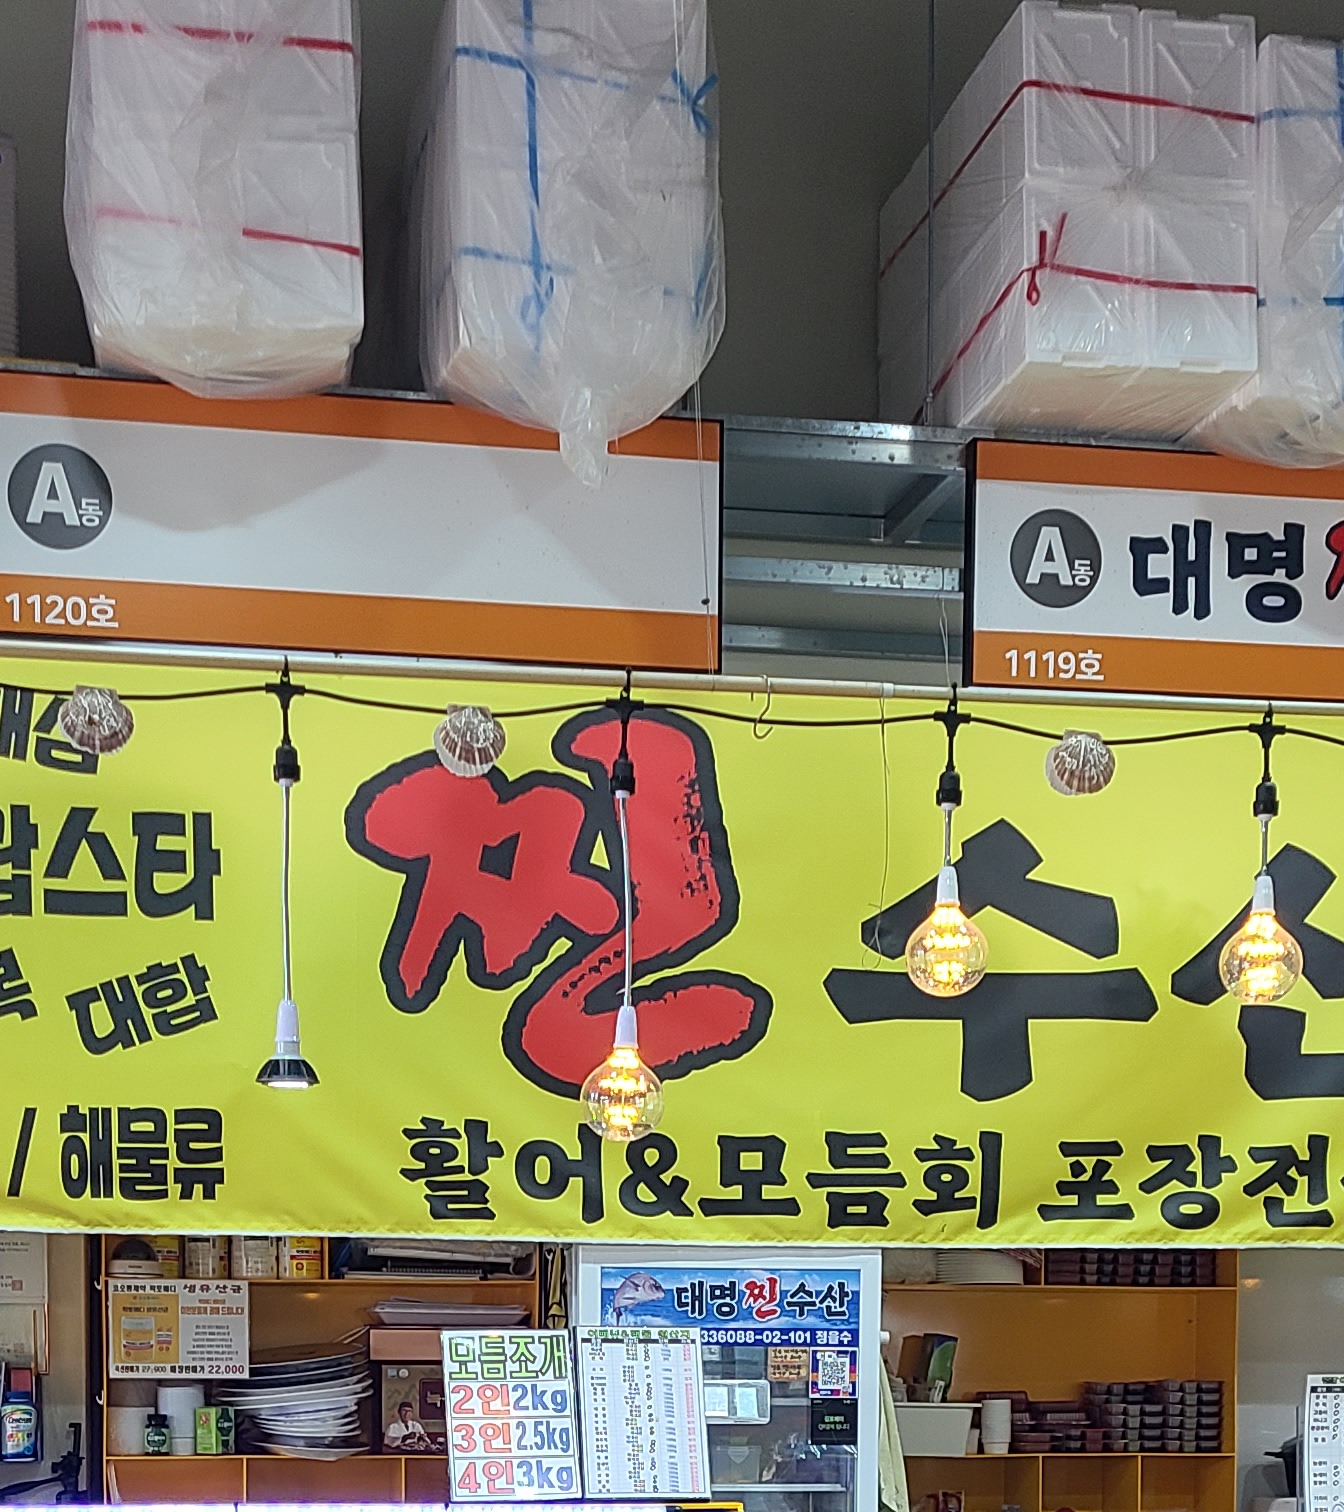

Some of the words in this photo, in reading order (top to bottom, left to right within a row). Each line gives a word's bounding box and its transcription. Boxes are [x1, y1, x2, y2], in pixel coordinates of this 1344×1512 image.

[4, 592, 118, 628] 1120호
[1004, 650, 1105, 682] 1119호
[65, 952, 219, 1057] 대합
[59, 1104, 226, 1201] 해물류
[399, 1115, 1004, 1230] 활어&모듬회
[208, 1365, 245, 1375] 22,000
[449, 1335, 568, 1380] 모듬조개
[451, 1384, 510, 1415] 2인
[512, 1384, 567, 1413] 2kg
[453, 1423, 512, 1453] 3인
[516, 1421, 570, 1453] 2.5kg
[458, 1460, 515, 1494] 4인
[517, 1460, 574, 1491] 3kg
